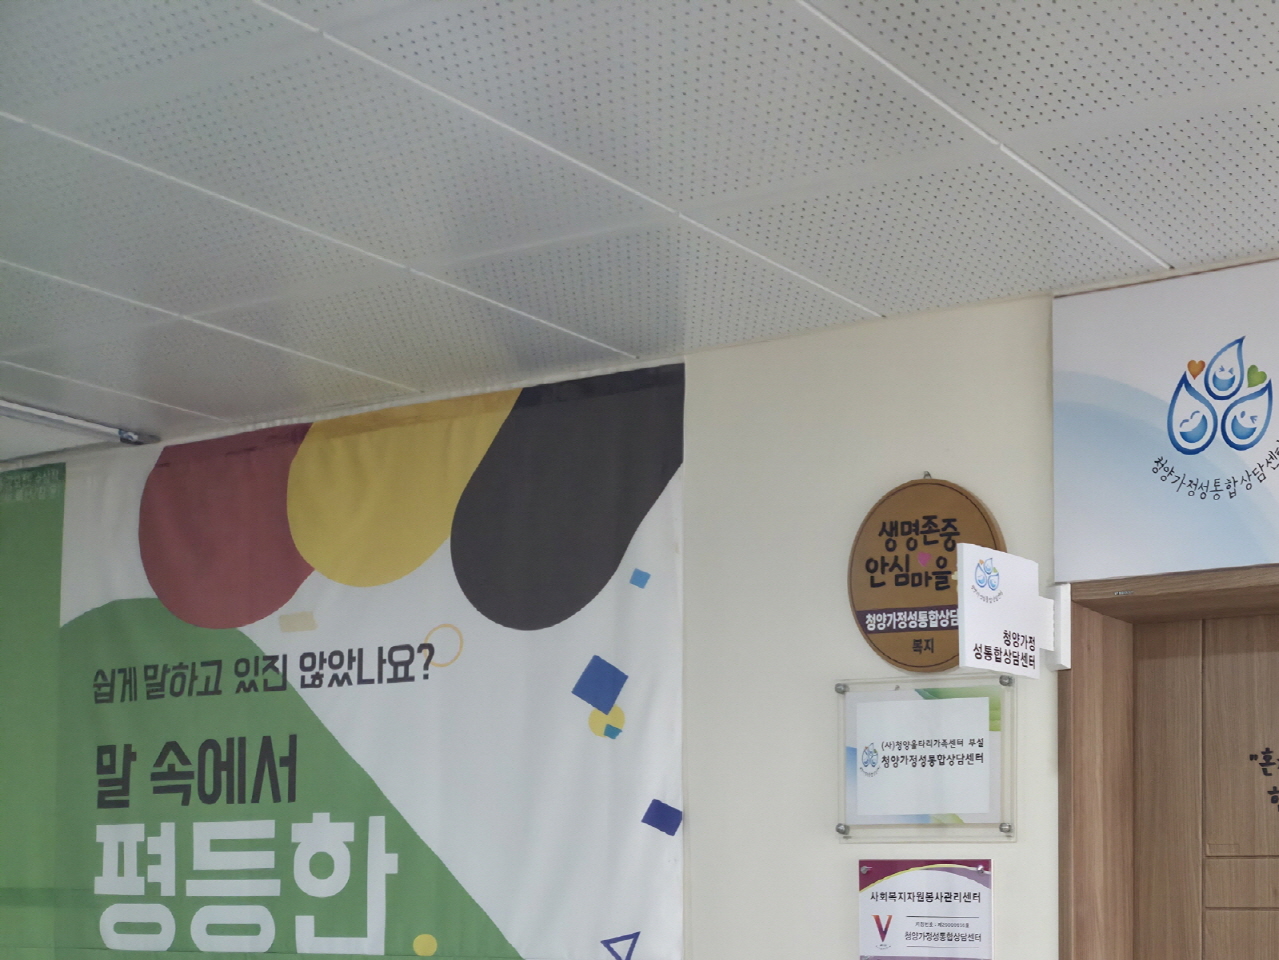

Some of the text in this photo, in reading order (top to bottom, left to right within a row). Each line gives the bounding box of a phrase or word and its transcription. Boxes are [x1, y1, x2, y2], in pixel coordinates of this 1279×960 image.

[878, 515, 960, 552] 생명존중
[1003, 630, 1035, 651] 청양가정
[973, 643, 1035, 669] 성통합상담센터
[93, 642, 435, 704] 쉽게 말하고 있진 않았나요?
[96, 734, 297, 809] 말 속에서
[881, 752, 984, 768] 청양가정성통합상담센터
[94, 813, 398, 956] 평등한
[870, 892, 981, 903] 사회복지자원봉사관리센터
[905, 931, 981, 942] 청양가정성통합상담센터
